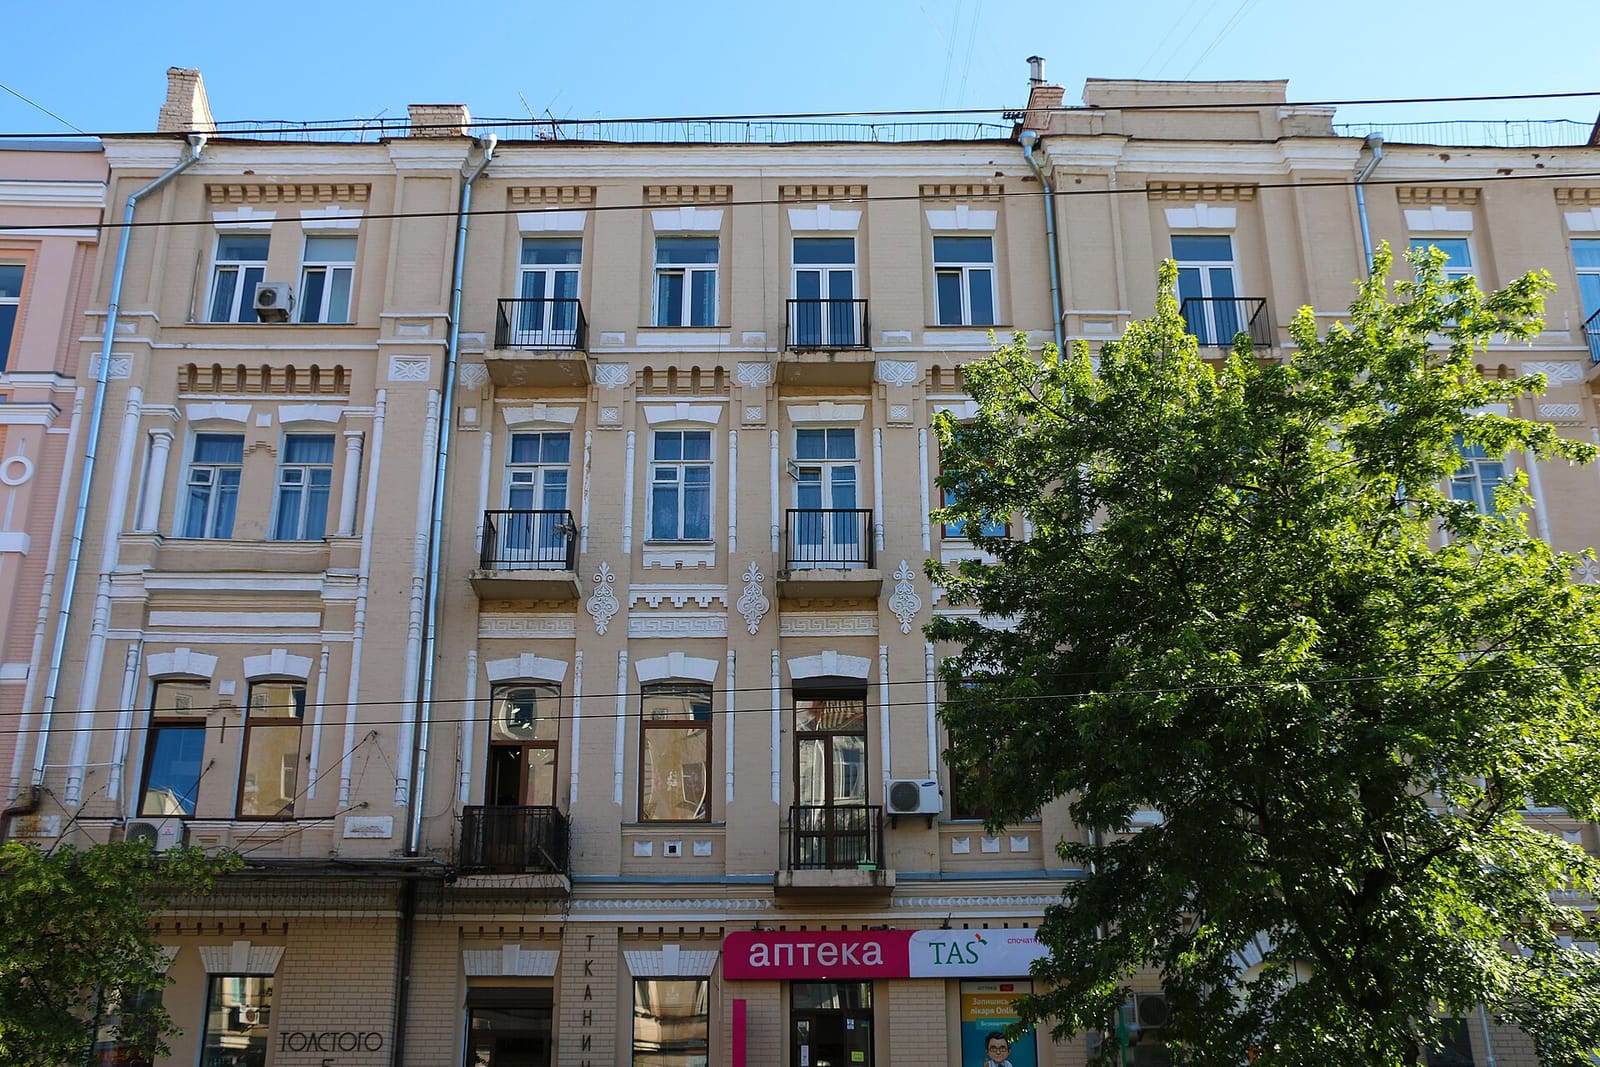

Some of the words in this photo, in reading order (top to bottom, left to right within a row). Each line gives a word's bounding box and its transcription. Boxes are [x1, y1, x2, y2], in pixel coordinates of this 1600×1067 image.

[749, 941, 883, 967] аптека
[929, 941, 979, 965] TAS
[280, 1032, 383, 1052] ТОЛСТОГО
